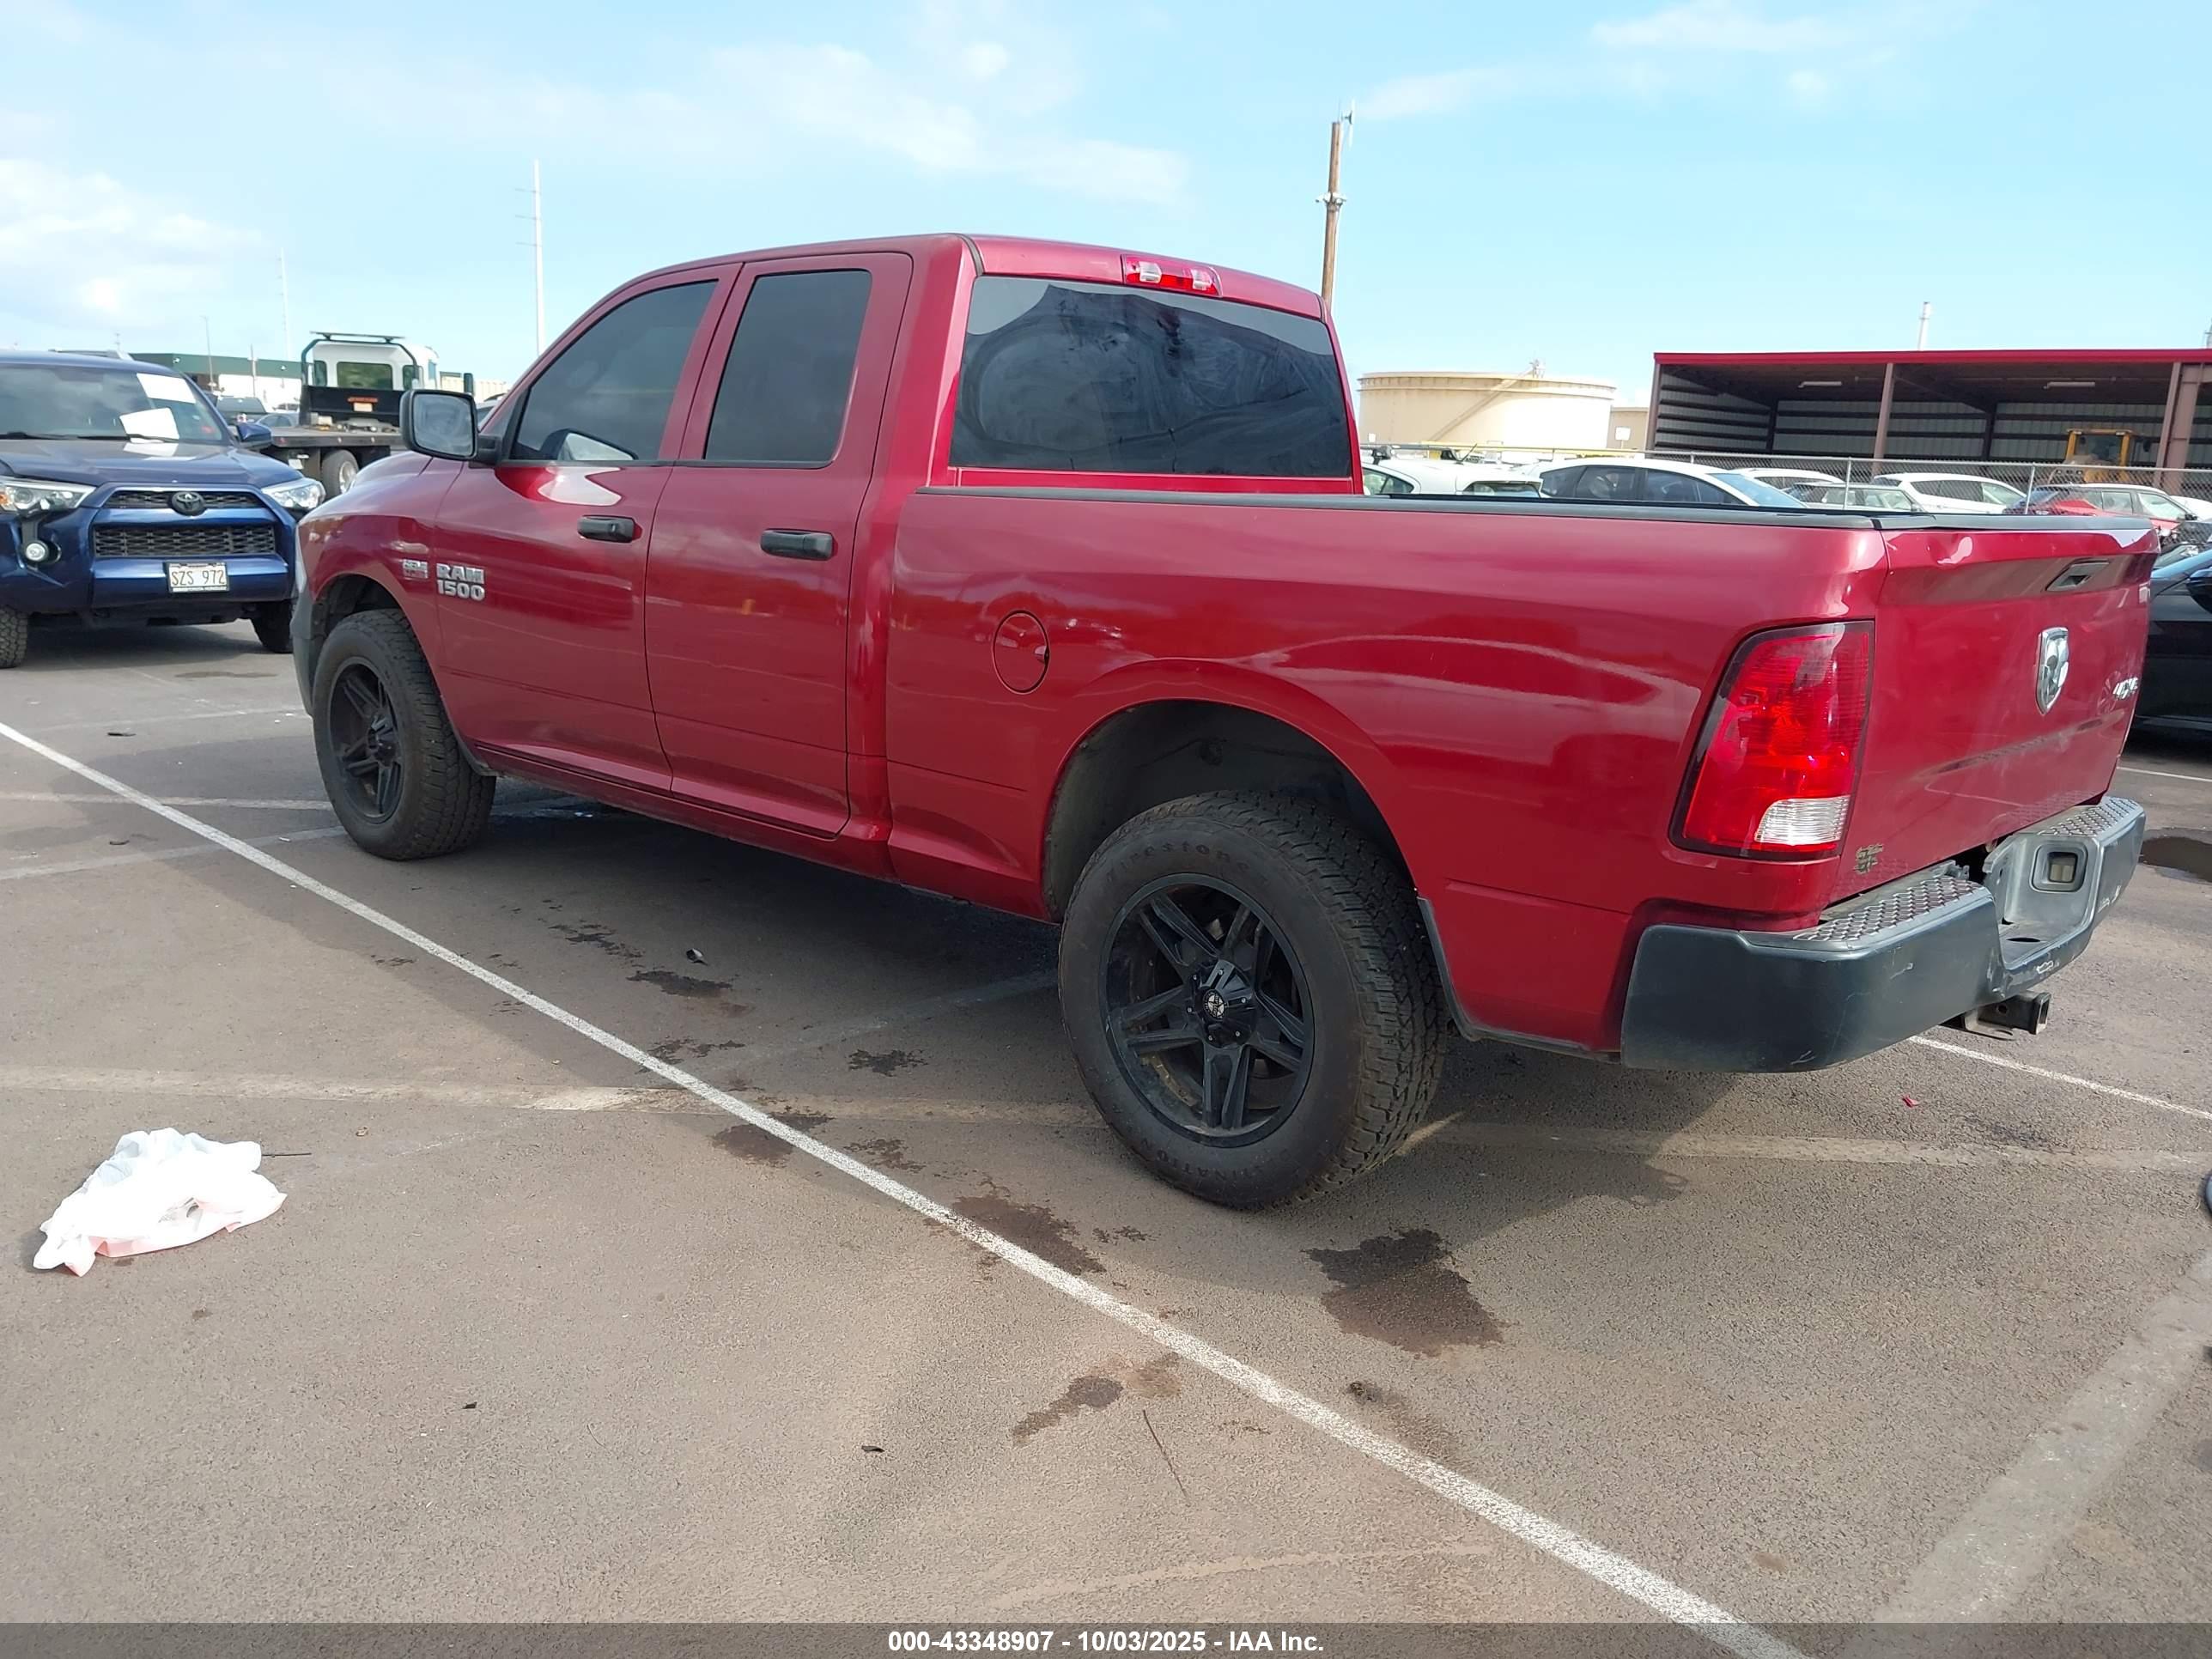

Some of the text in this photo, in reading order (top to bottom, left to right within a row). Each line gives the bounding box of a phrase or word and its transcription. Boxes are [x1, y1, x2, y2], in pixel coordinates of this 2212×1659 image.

[171, 569, 226, 586] SZS 972
[436, 563, 484, 584] RAM
[437, 580, 485, 601] 1500
